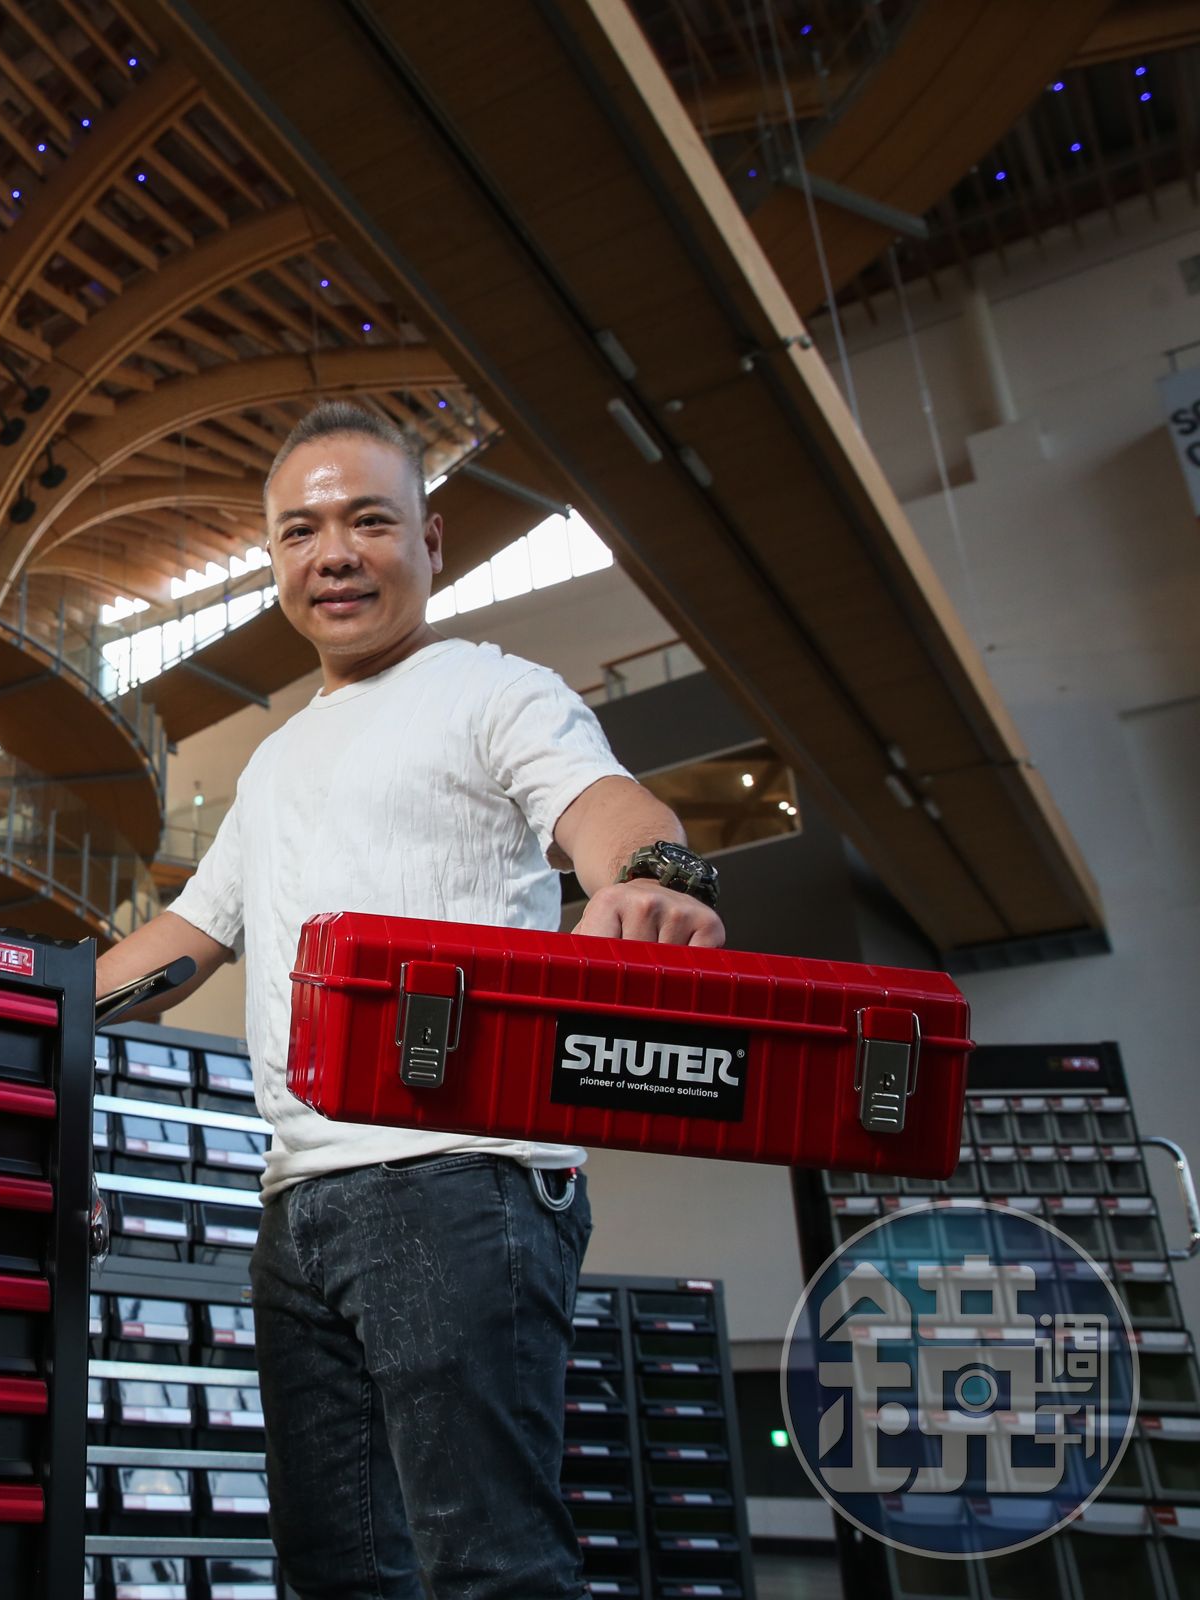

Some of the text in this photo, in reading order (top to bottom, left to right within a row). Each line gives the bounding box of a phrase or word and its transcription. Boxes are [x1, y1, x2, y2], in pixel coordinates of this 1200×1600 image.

[580, 1076, 719, 1098] pioneer of workspace solutions
